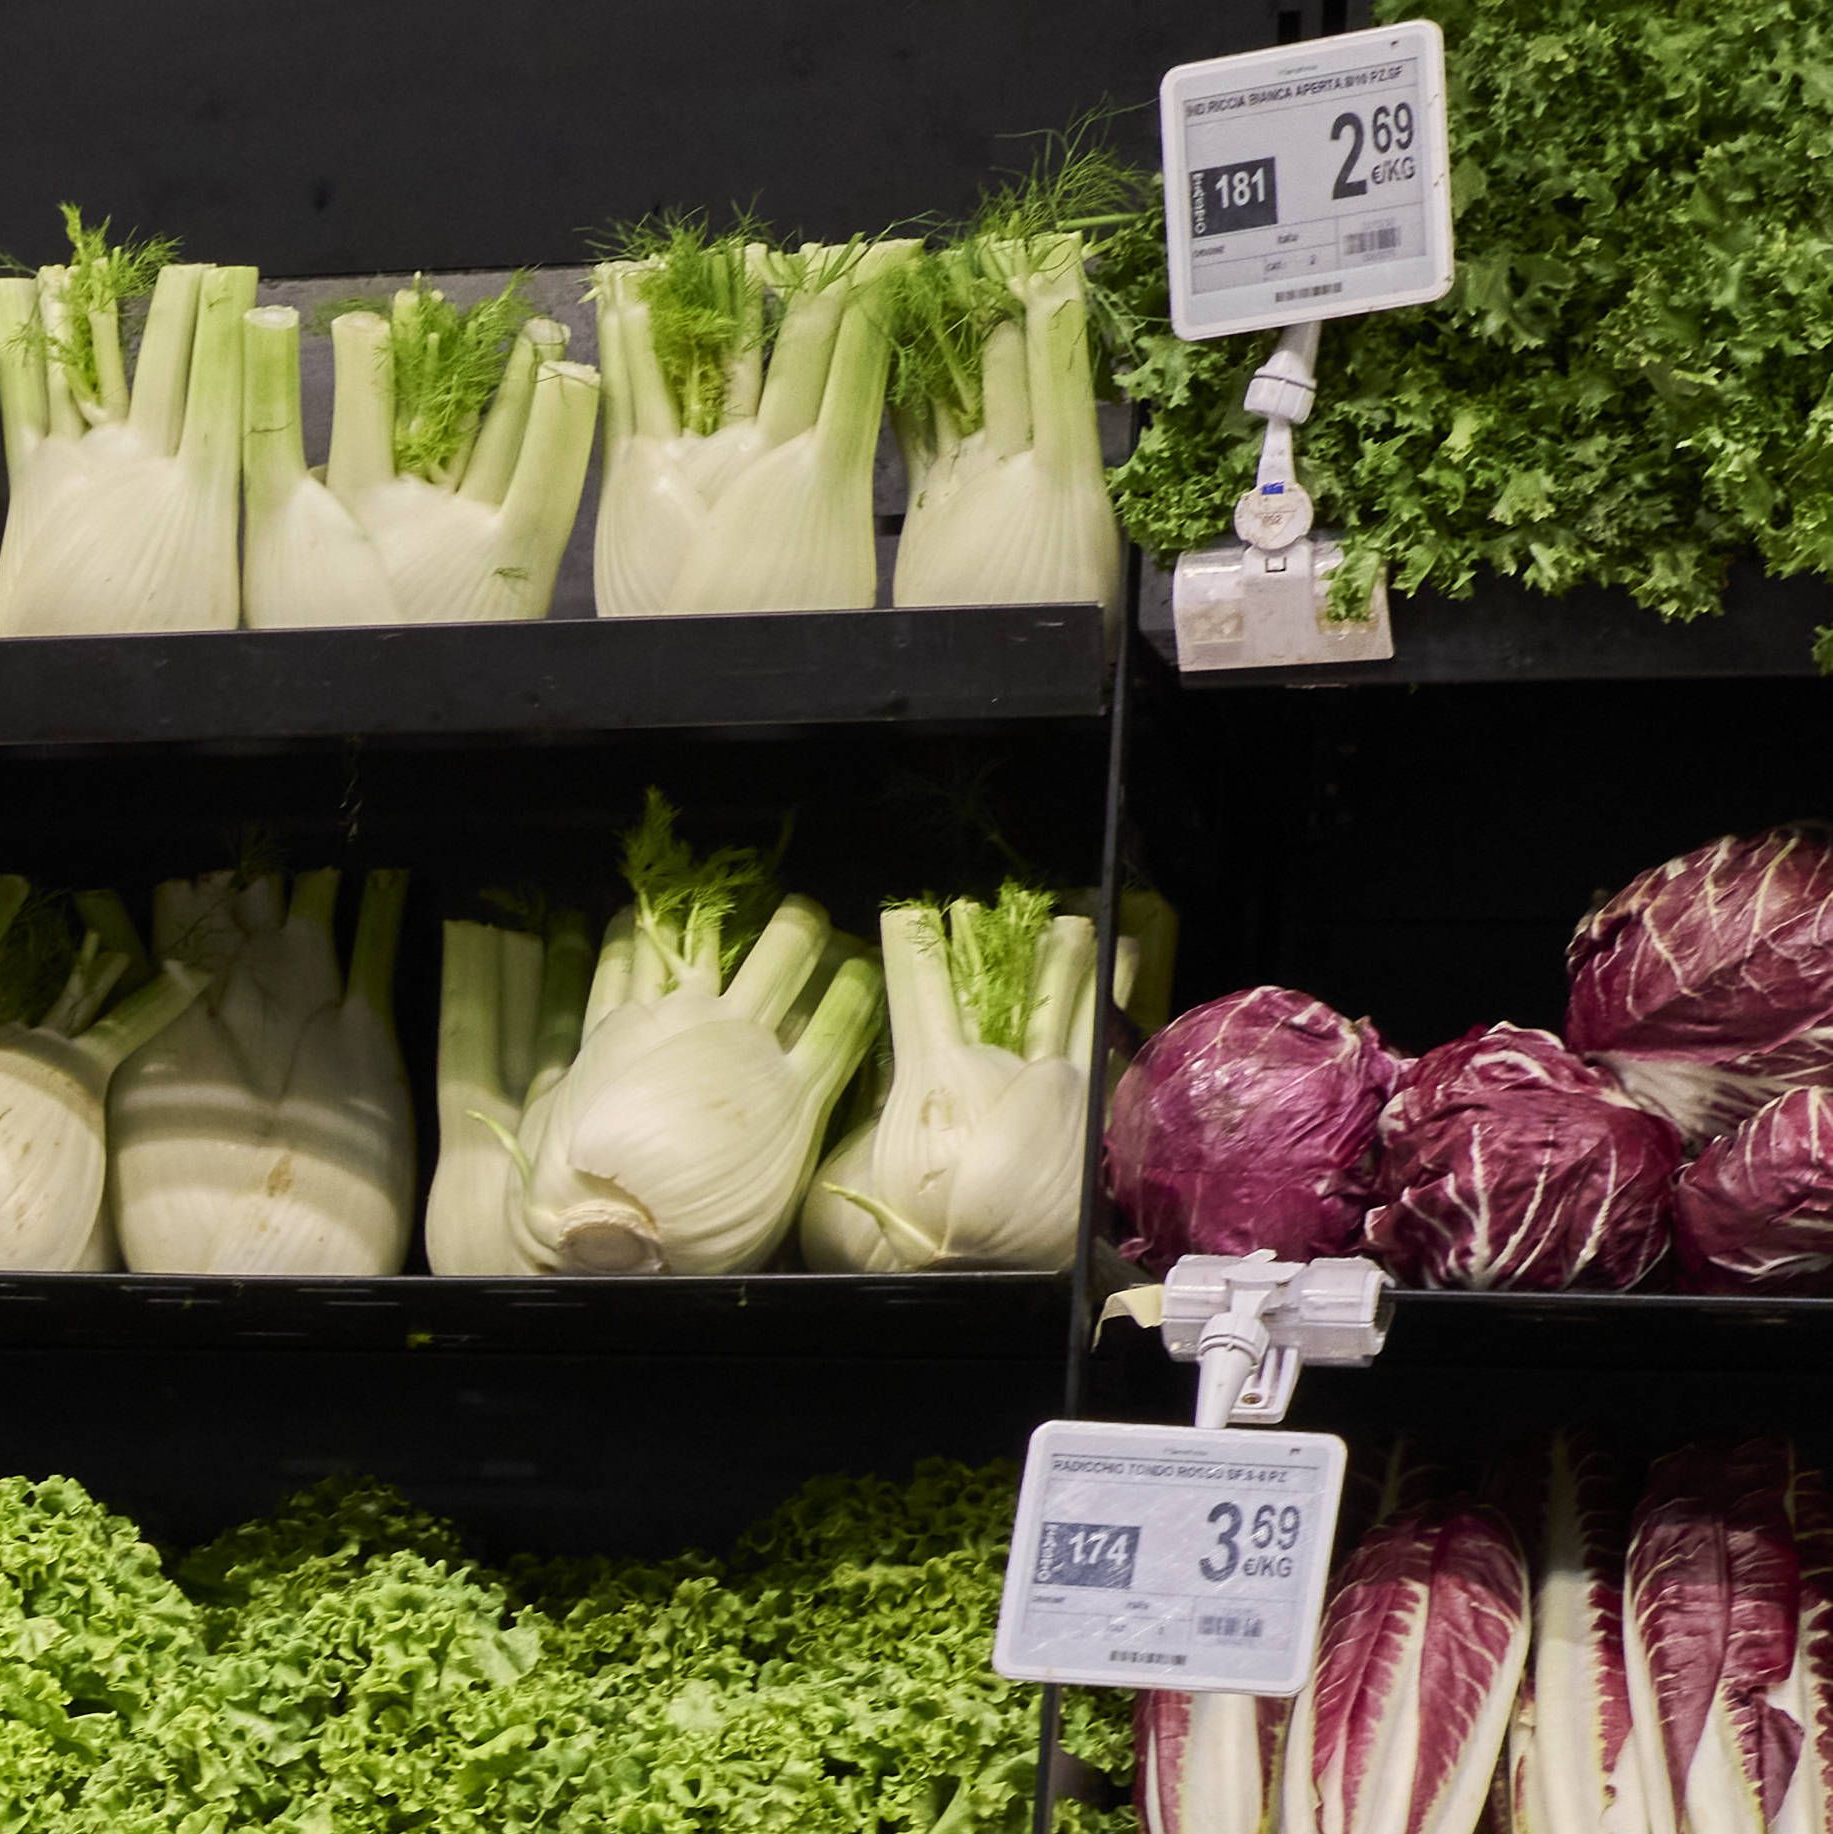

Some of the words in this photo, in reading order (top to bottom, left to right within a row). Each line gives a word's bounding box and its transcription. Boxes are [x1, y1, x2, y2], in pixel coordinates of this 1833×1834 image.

[1247, 84, 1293, 108] BIANCA
[1330, 112, 1368, 200] 2
[1372, 101, 1414, 153] 69
[1371, 156, 1416, 185] €/KG
[1215, 166, 1266, 209] 181
[1049, 1456, 1125, 1477] RADICCHIO
[1126, 1460, 1174, 1479] TONDO
[1069, 1531, 1129, 1566] 174
[1198, 1501, 1243, 1582] 3
[1253, 1504, 1301, 1550] 69
[1243, 1556, 1293, 1579] €/KG
